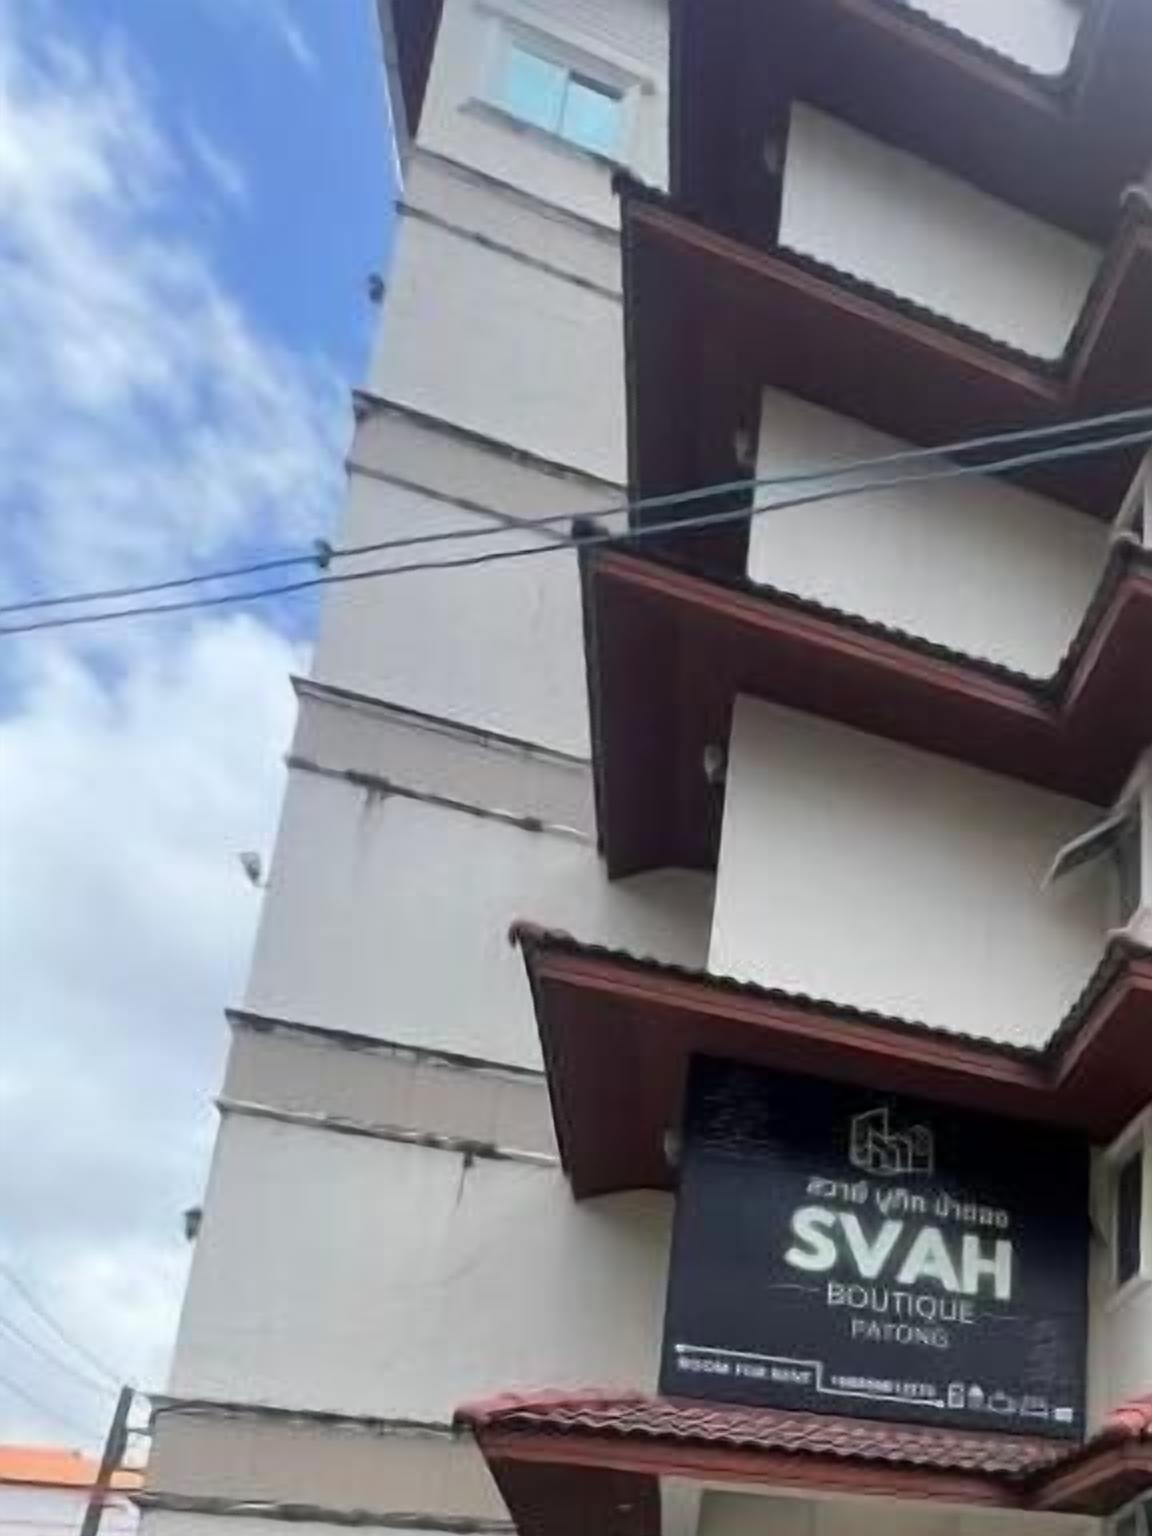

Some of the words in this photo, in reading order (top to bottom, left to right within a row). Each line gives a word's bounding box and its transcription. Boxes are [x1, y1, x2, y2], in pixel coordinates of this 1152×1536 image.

[785, 1205, 1012, 1300] SVAH
[827, 1280, 974, 1325] BOUTIQUE
[851, 1318, 948, 1348] PATONG
